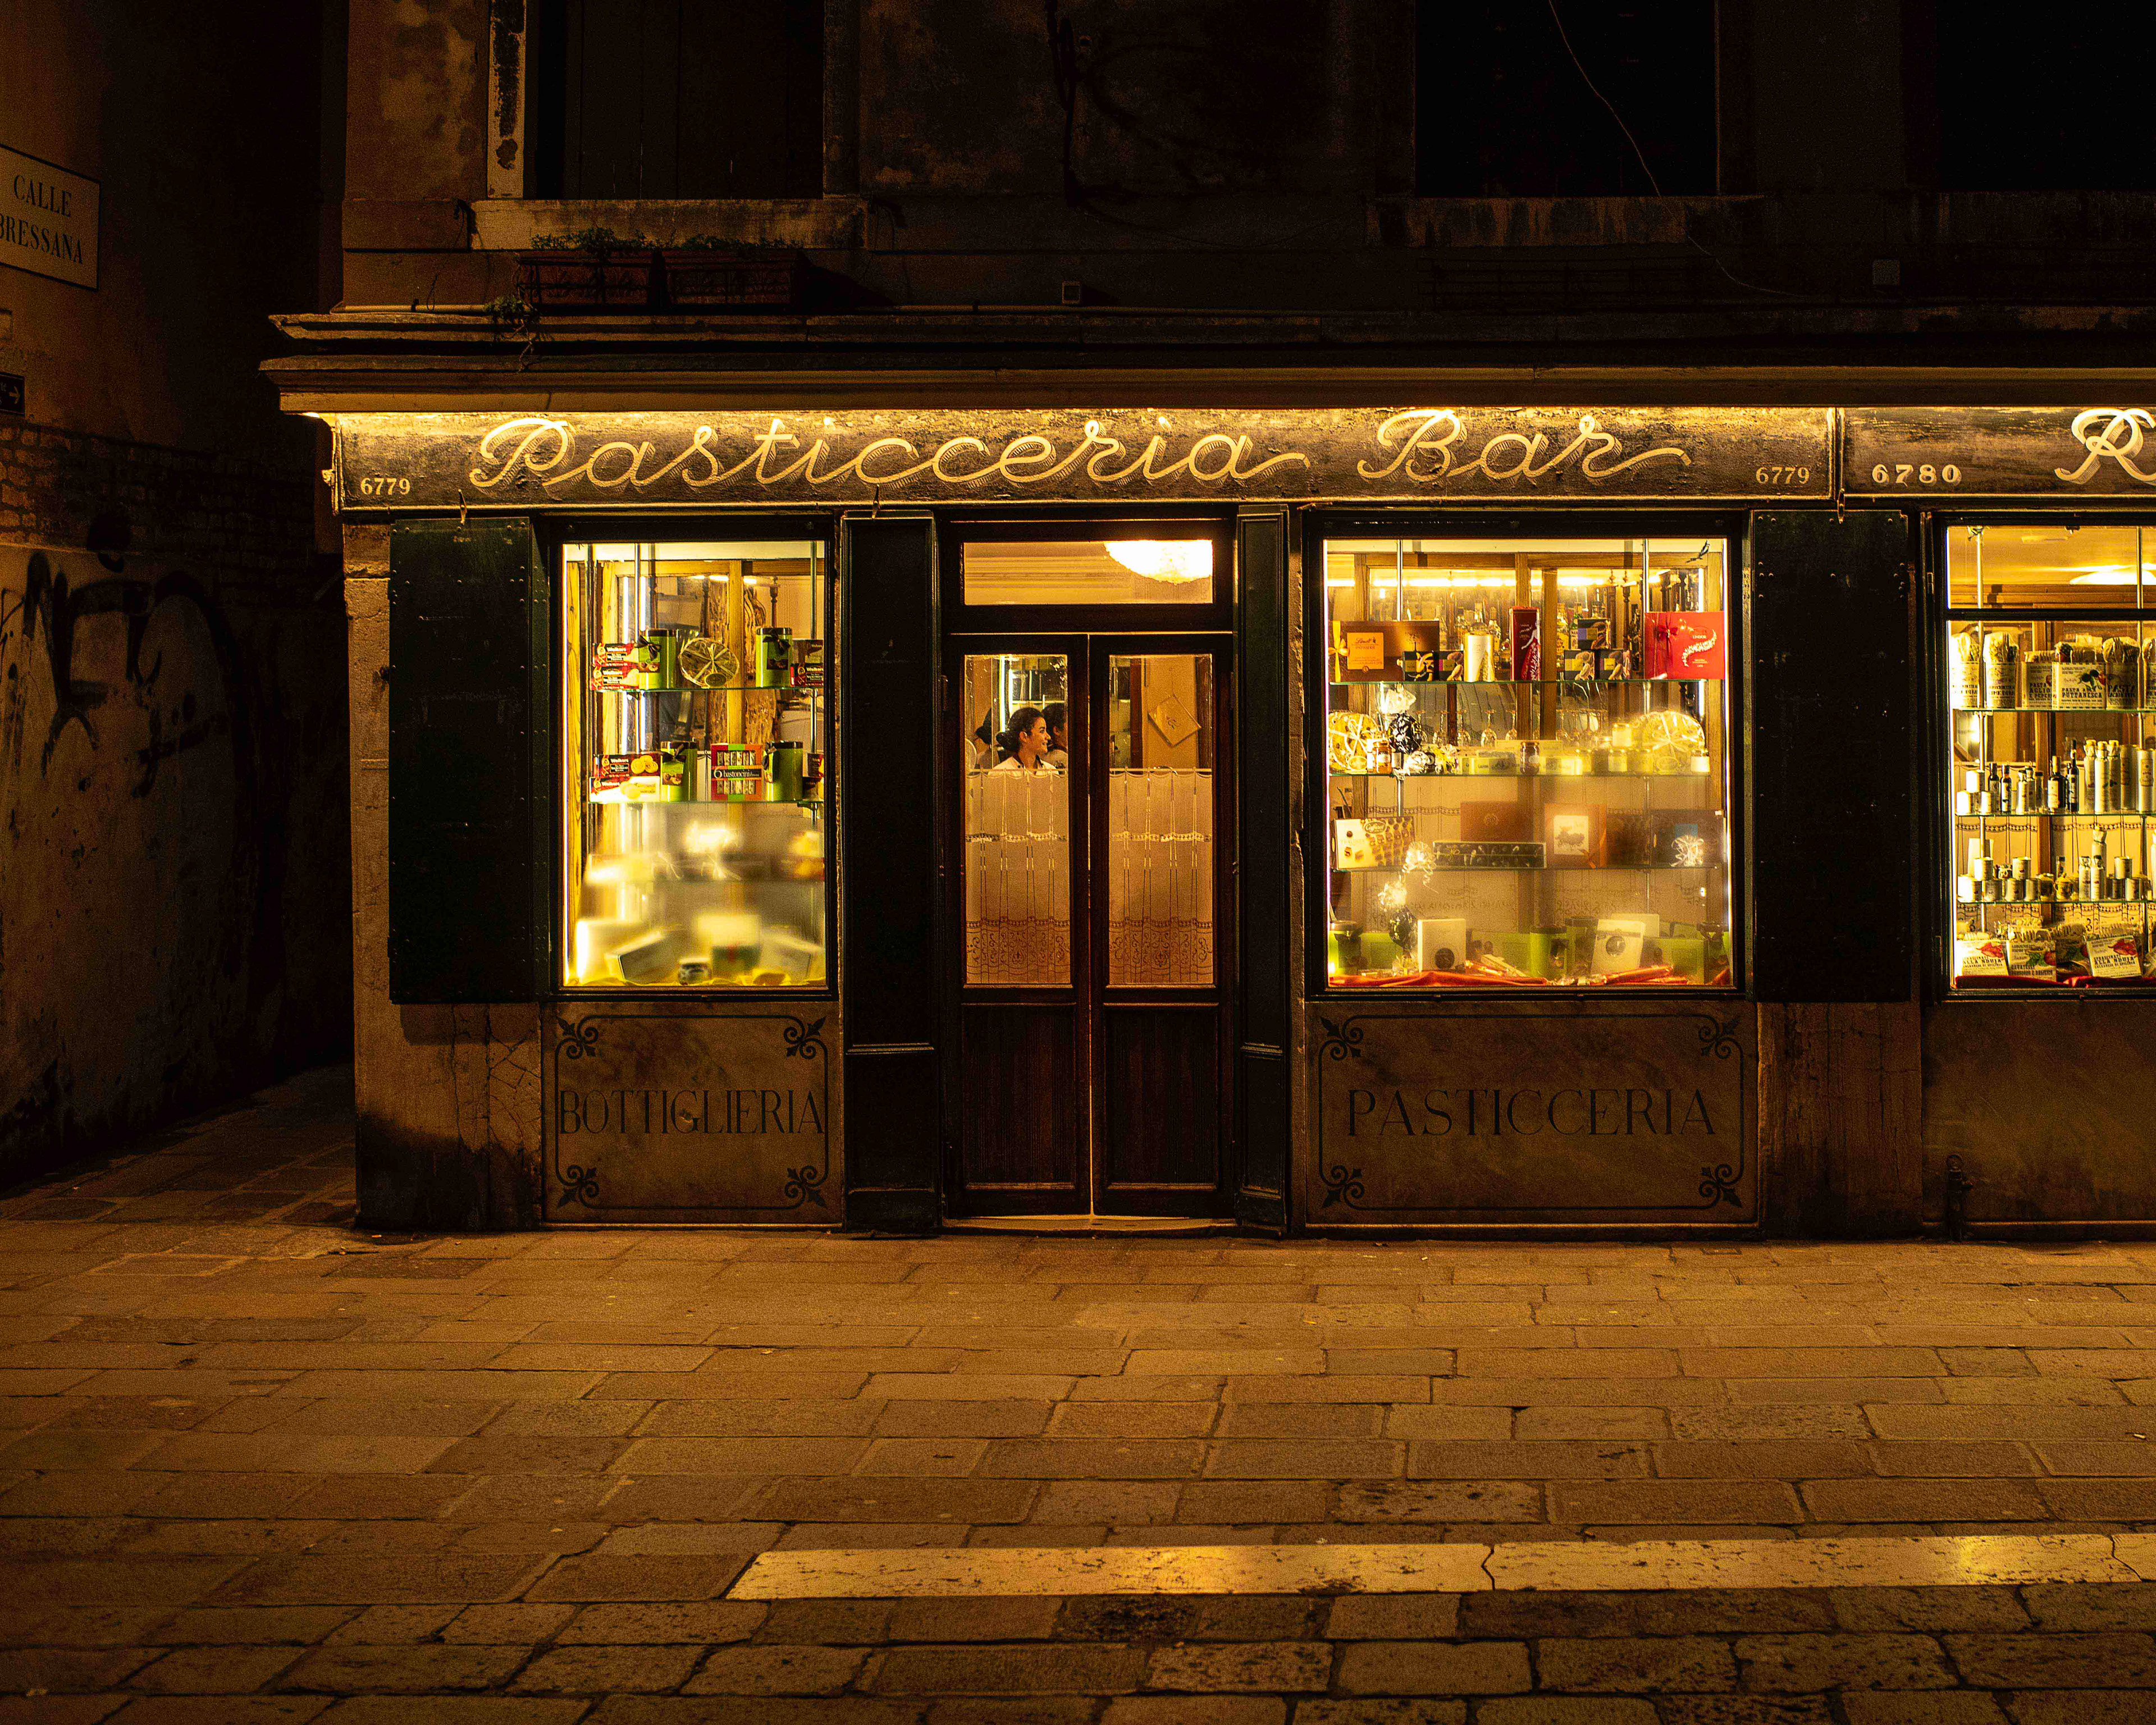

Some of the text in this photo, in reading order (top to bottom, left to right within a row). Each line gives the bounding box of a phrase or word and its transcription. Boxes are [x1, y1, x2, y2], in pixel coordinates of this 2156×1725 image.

[13, 175, 72, 217] CALLE
[469, 408, 1691, 490] Pasticceria Bar
[360, 477, 411, 496] 6779
[1755, 466, 1810, 485] 6779
[1871, 464, 1962, 486] 6780
[714, 765, 723, 779] 6
[723, 769, 750, 778] bastoncini
[560, 1089, 824, 1134] BOTTIGLIERIA
[1347, 1088, 1716, 1136] PASTICCERIA
